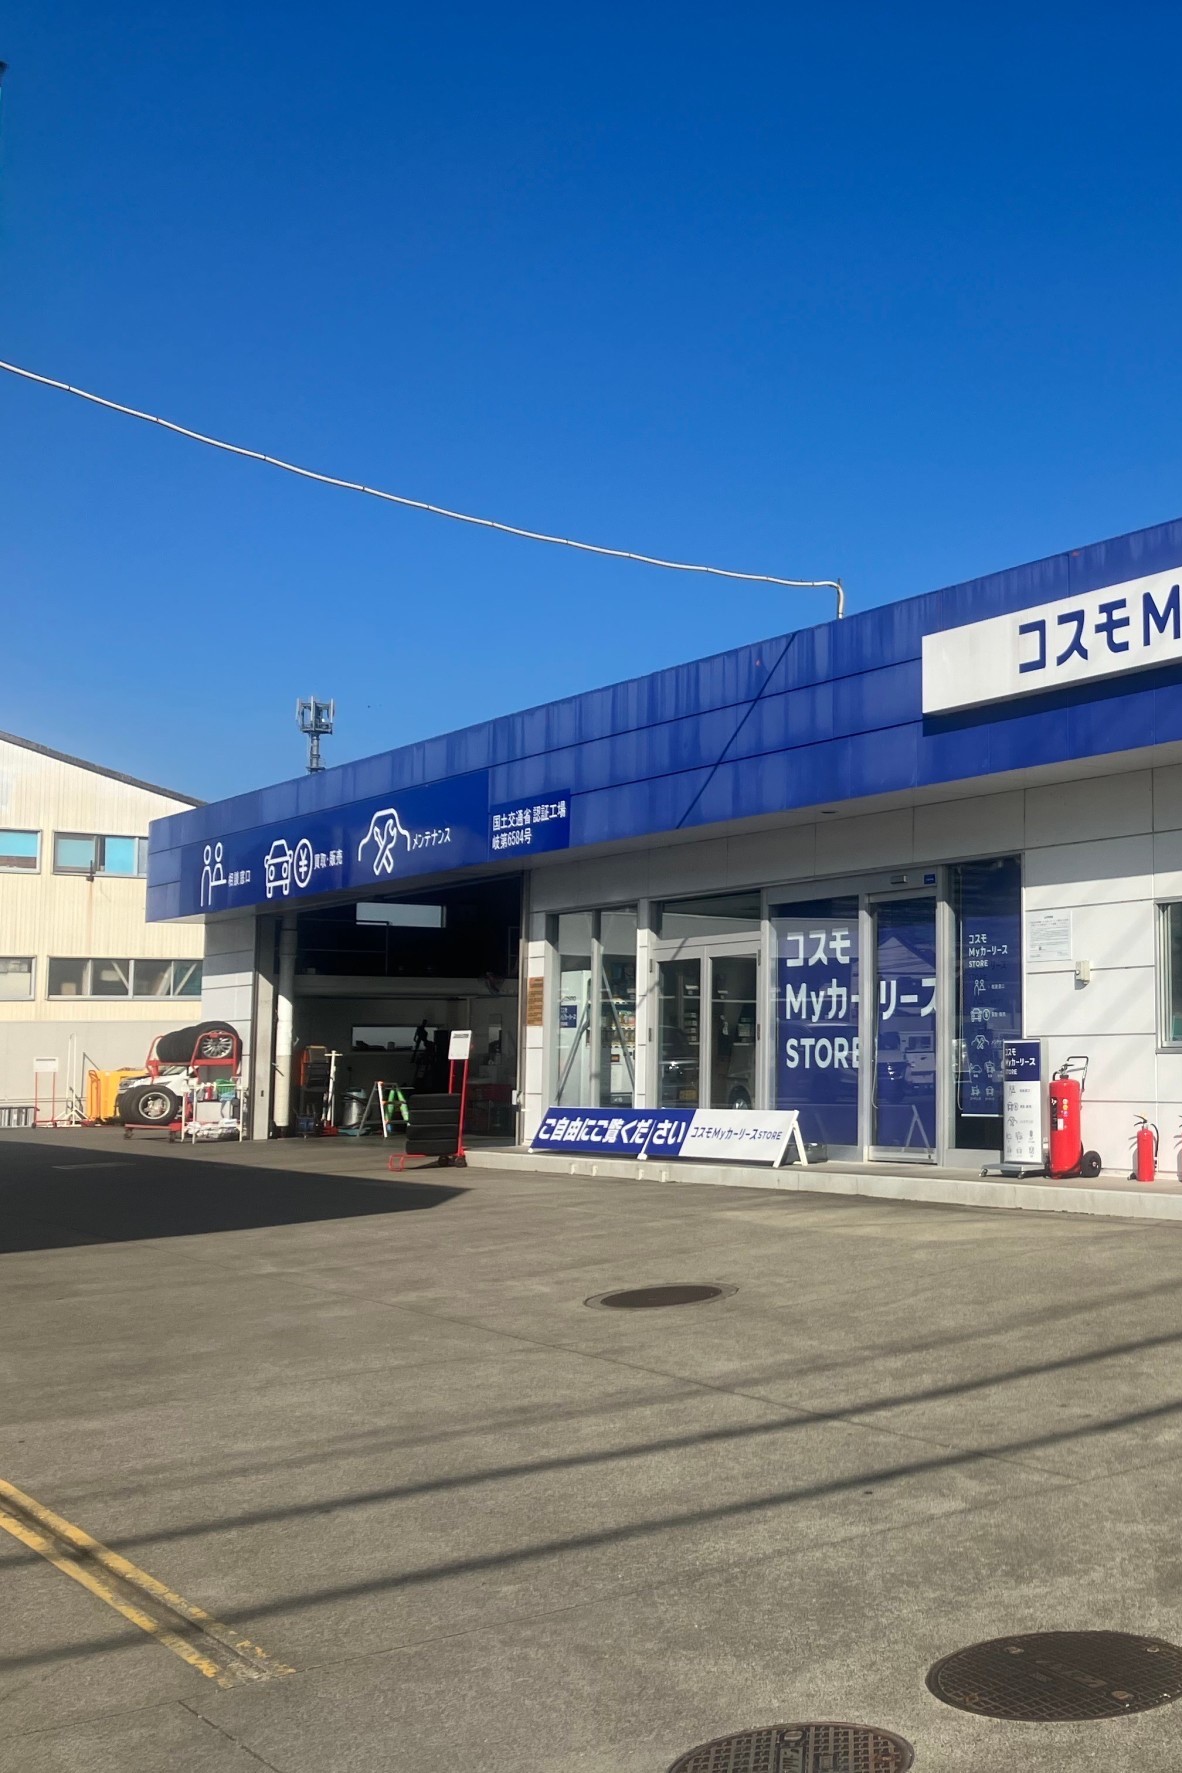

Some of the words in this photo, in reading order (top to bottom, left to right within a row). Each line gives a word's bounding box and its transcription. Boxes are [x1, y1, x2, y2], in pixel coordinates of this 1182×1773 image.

[412, 827, 451, 850] メンテナンス
[492, 827, 532, 850] 岐第6584号
[786, 928, 851, 967] コスモ
[968, 933, 988, 944] コスモ
[968, 944, 1009, 957] Myカーリース
[968, 959, 989, 968] STORE
[786, 1037, 860, 1069] STORE
[538, 1116, 687, 1146] ご自由にご覧ください
